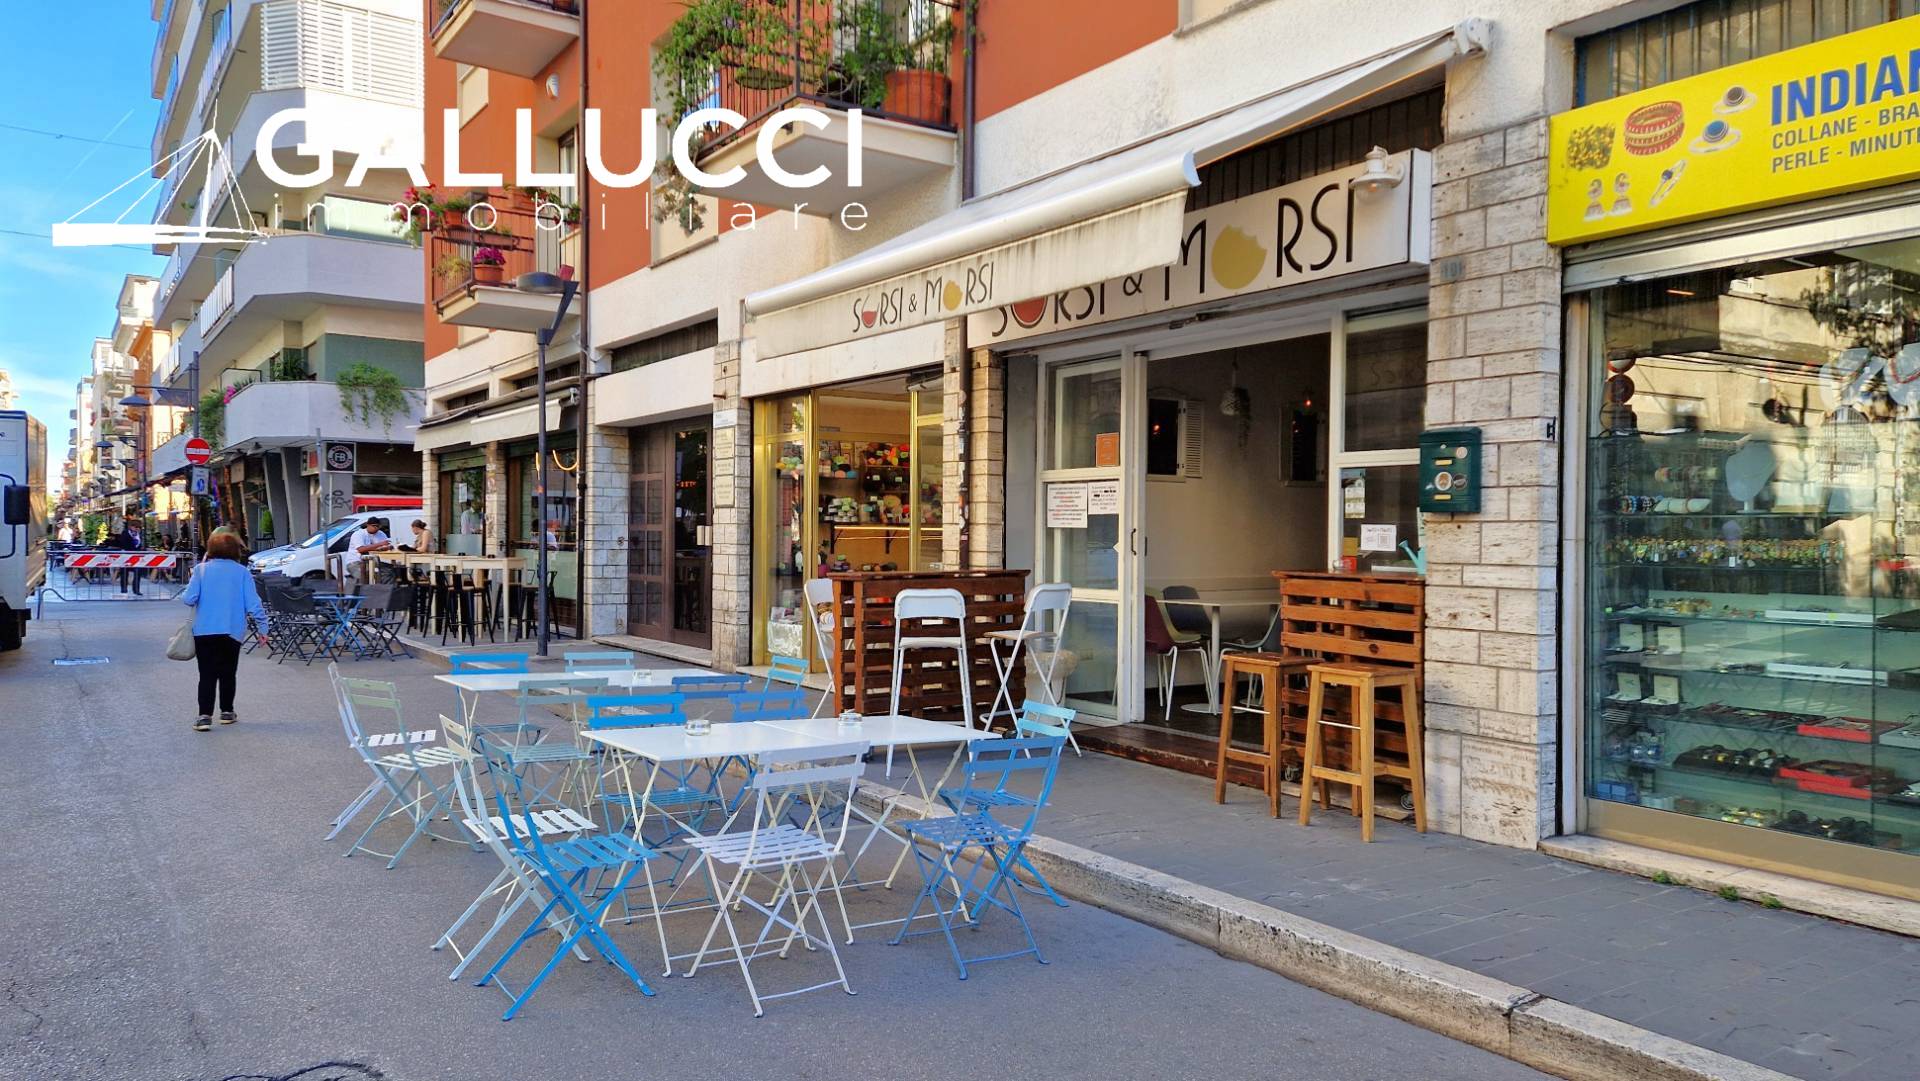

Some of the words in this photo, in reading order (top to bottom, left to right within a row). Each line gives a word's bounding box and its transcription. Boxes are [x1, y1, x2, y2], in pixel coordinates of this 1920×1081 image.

[1772, 115, 1857, 150] COLLANE
[1879, 102, 1920, 126] BRA
[1772, 146, 1830, 173] PERLE
[908, 293, 918, 313] &
